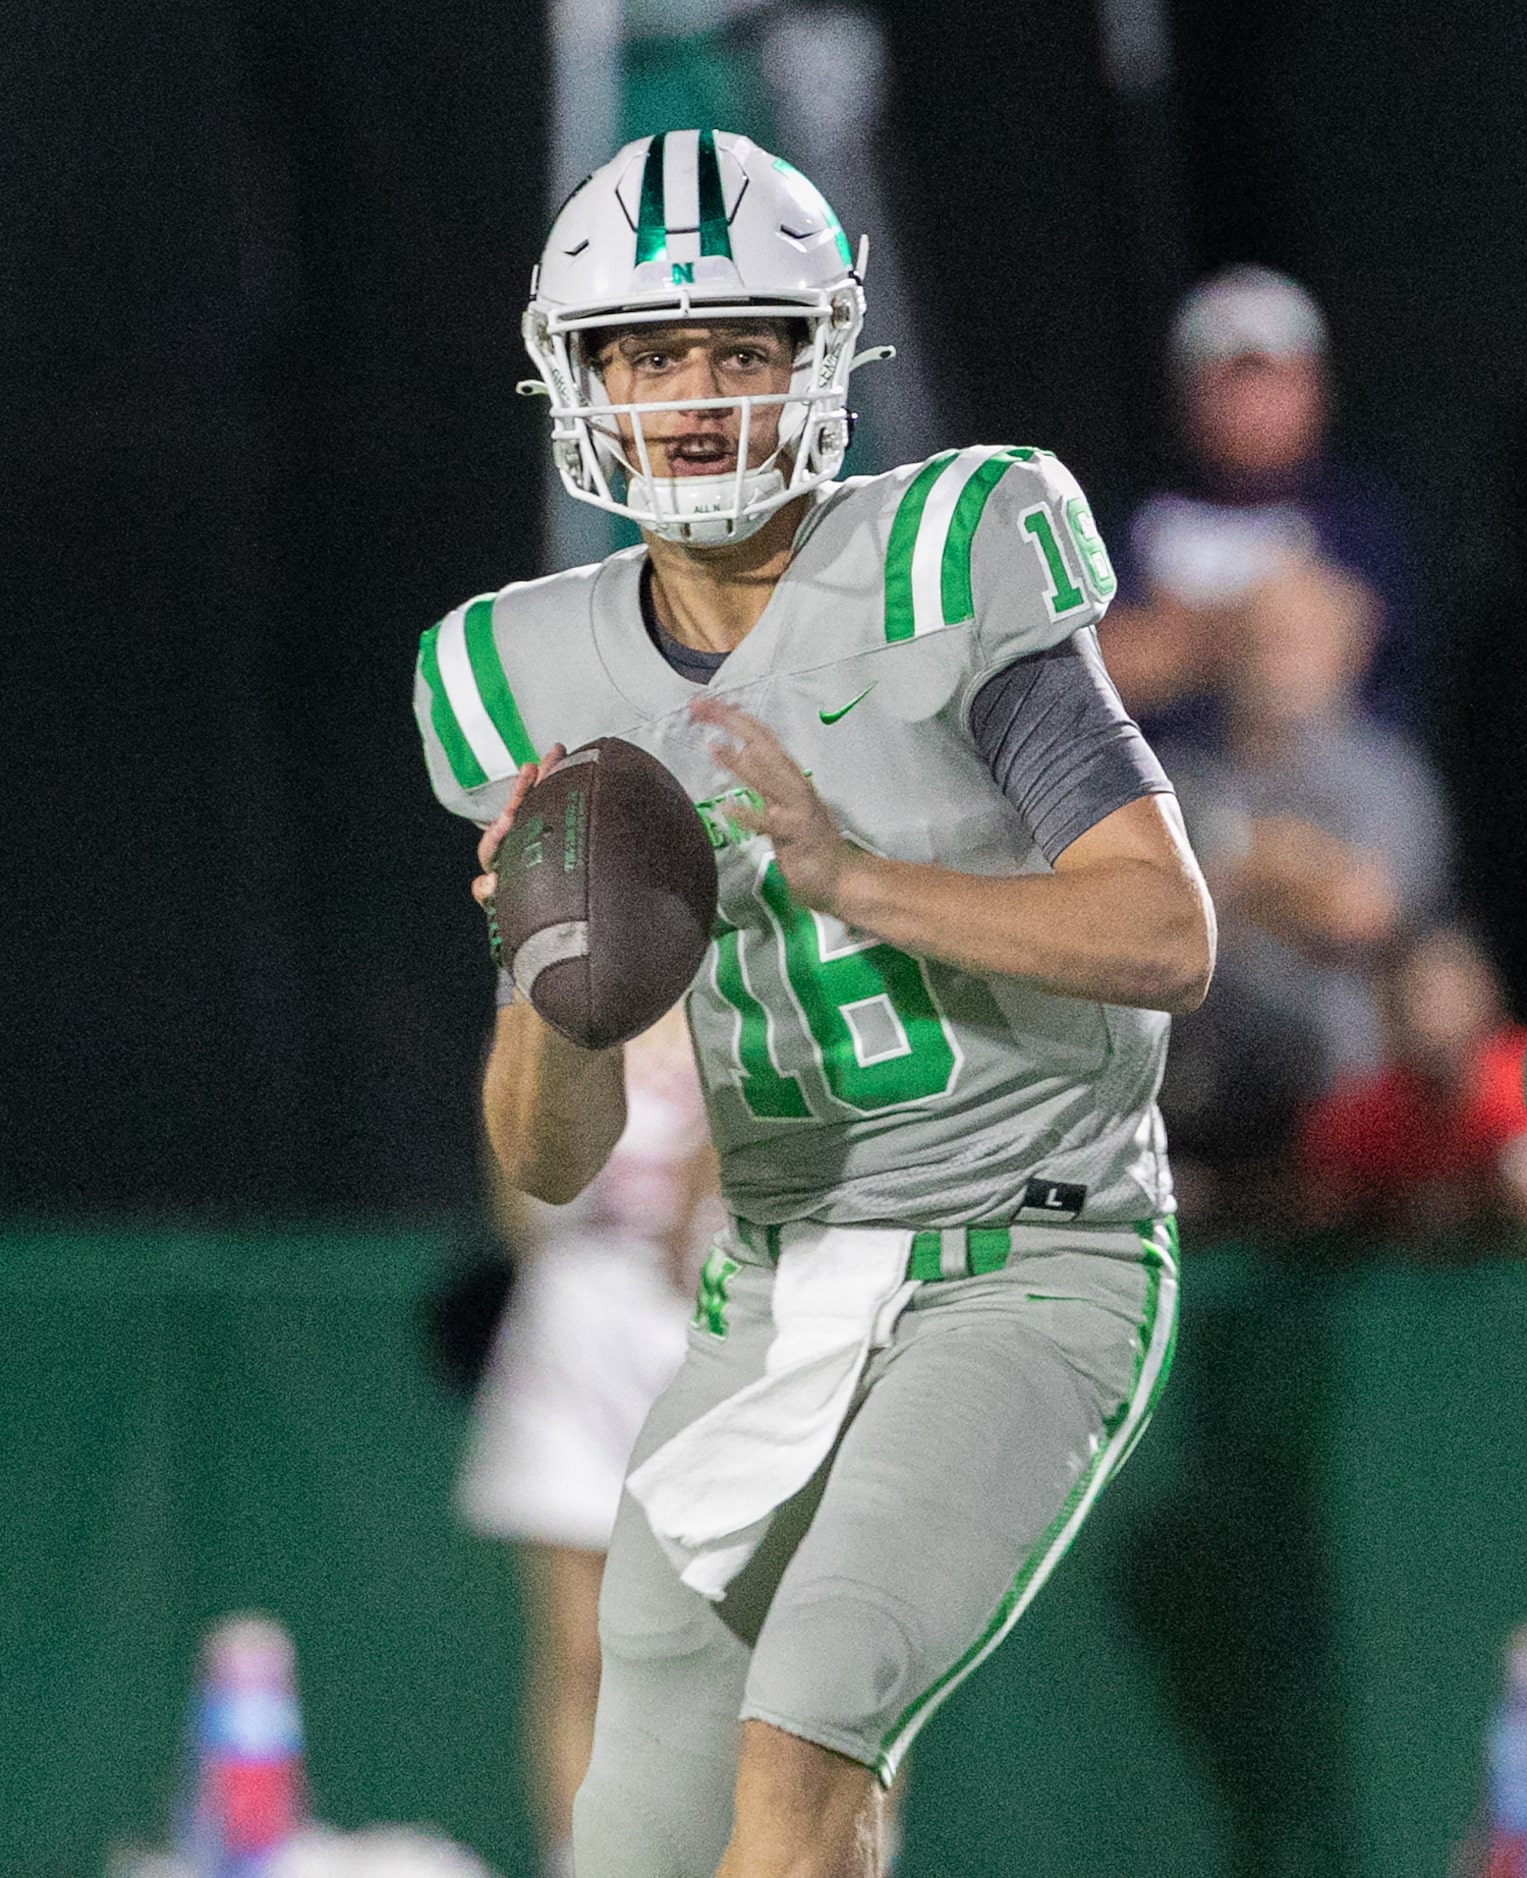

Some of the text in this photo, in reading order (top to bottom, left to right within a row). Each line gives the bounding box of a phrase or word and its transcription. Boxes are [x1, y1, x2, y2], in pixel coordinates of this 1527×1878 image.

[672, 262, 695, 285] N
[1018, 499, 1117, 622] 16
[707, 851, 964, 1122] 16
[1045, 1188, 1063, 1207] L
